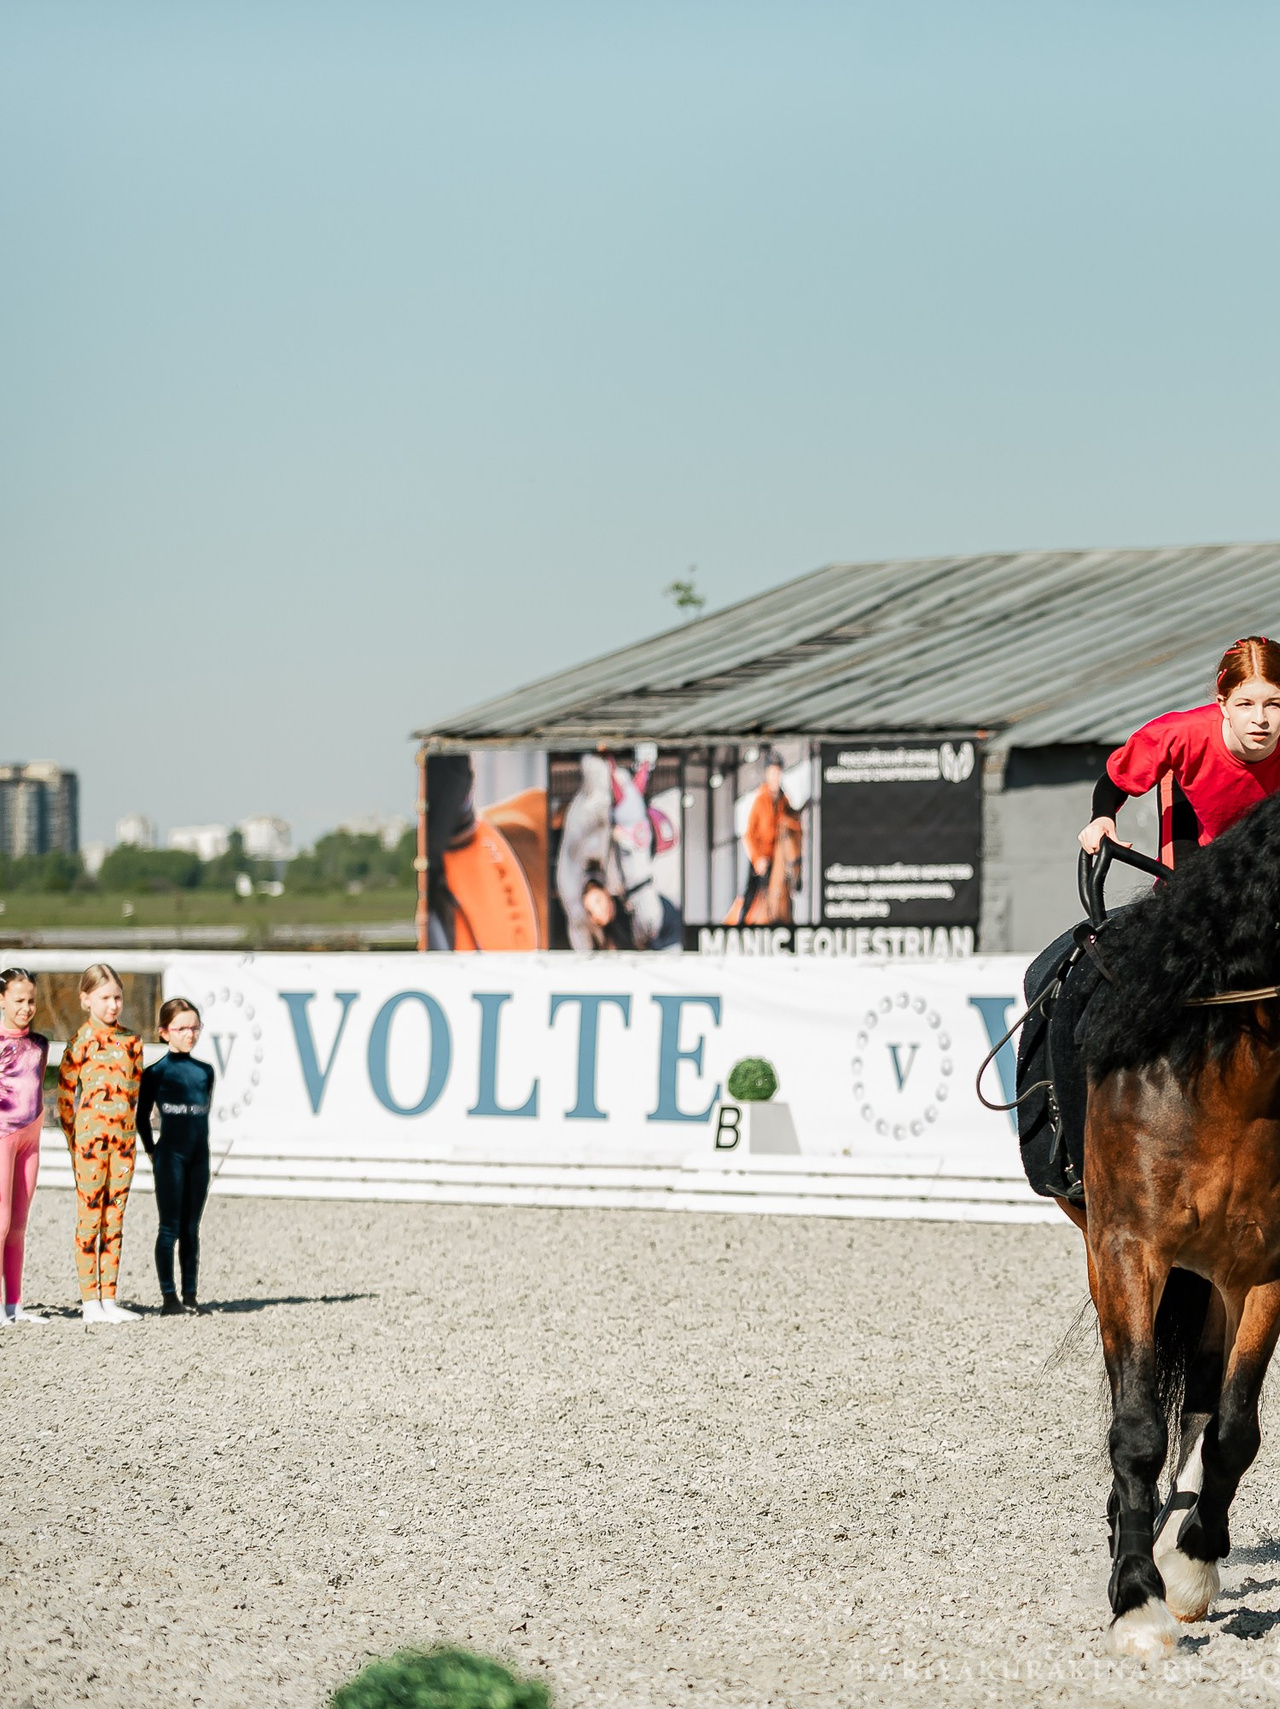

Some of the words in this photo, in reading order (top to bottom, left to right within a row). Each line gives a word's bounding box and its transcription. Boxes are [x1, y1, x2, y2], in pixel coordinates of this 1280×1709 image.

[698, 926, 791, 957] MANIC
[794, 926, 975, 957] EQUESTRIAN
[210, 1033, 237, 1080] V
[282, 992, 720, 1122] VOLTE
[886, 1043, 920, 1092] V
[715, 1106, 742, 1149] B
